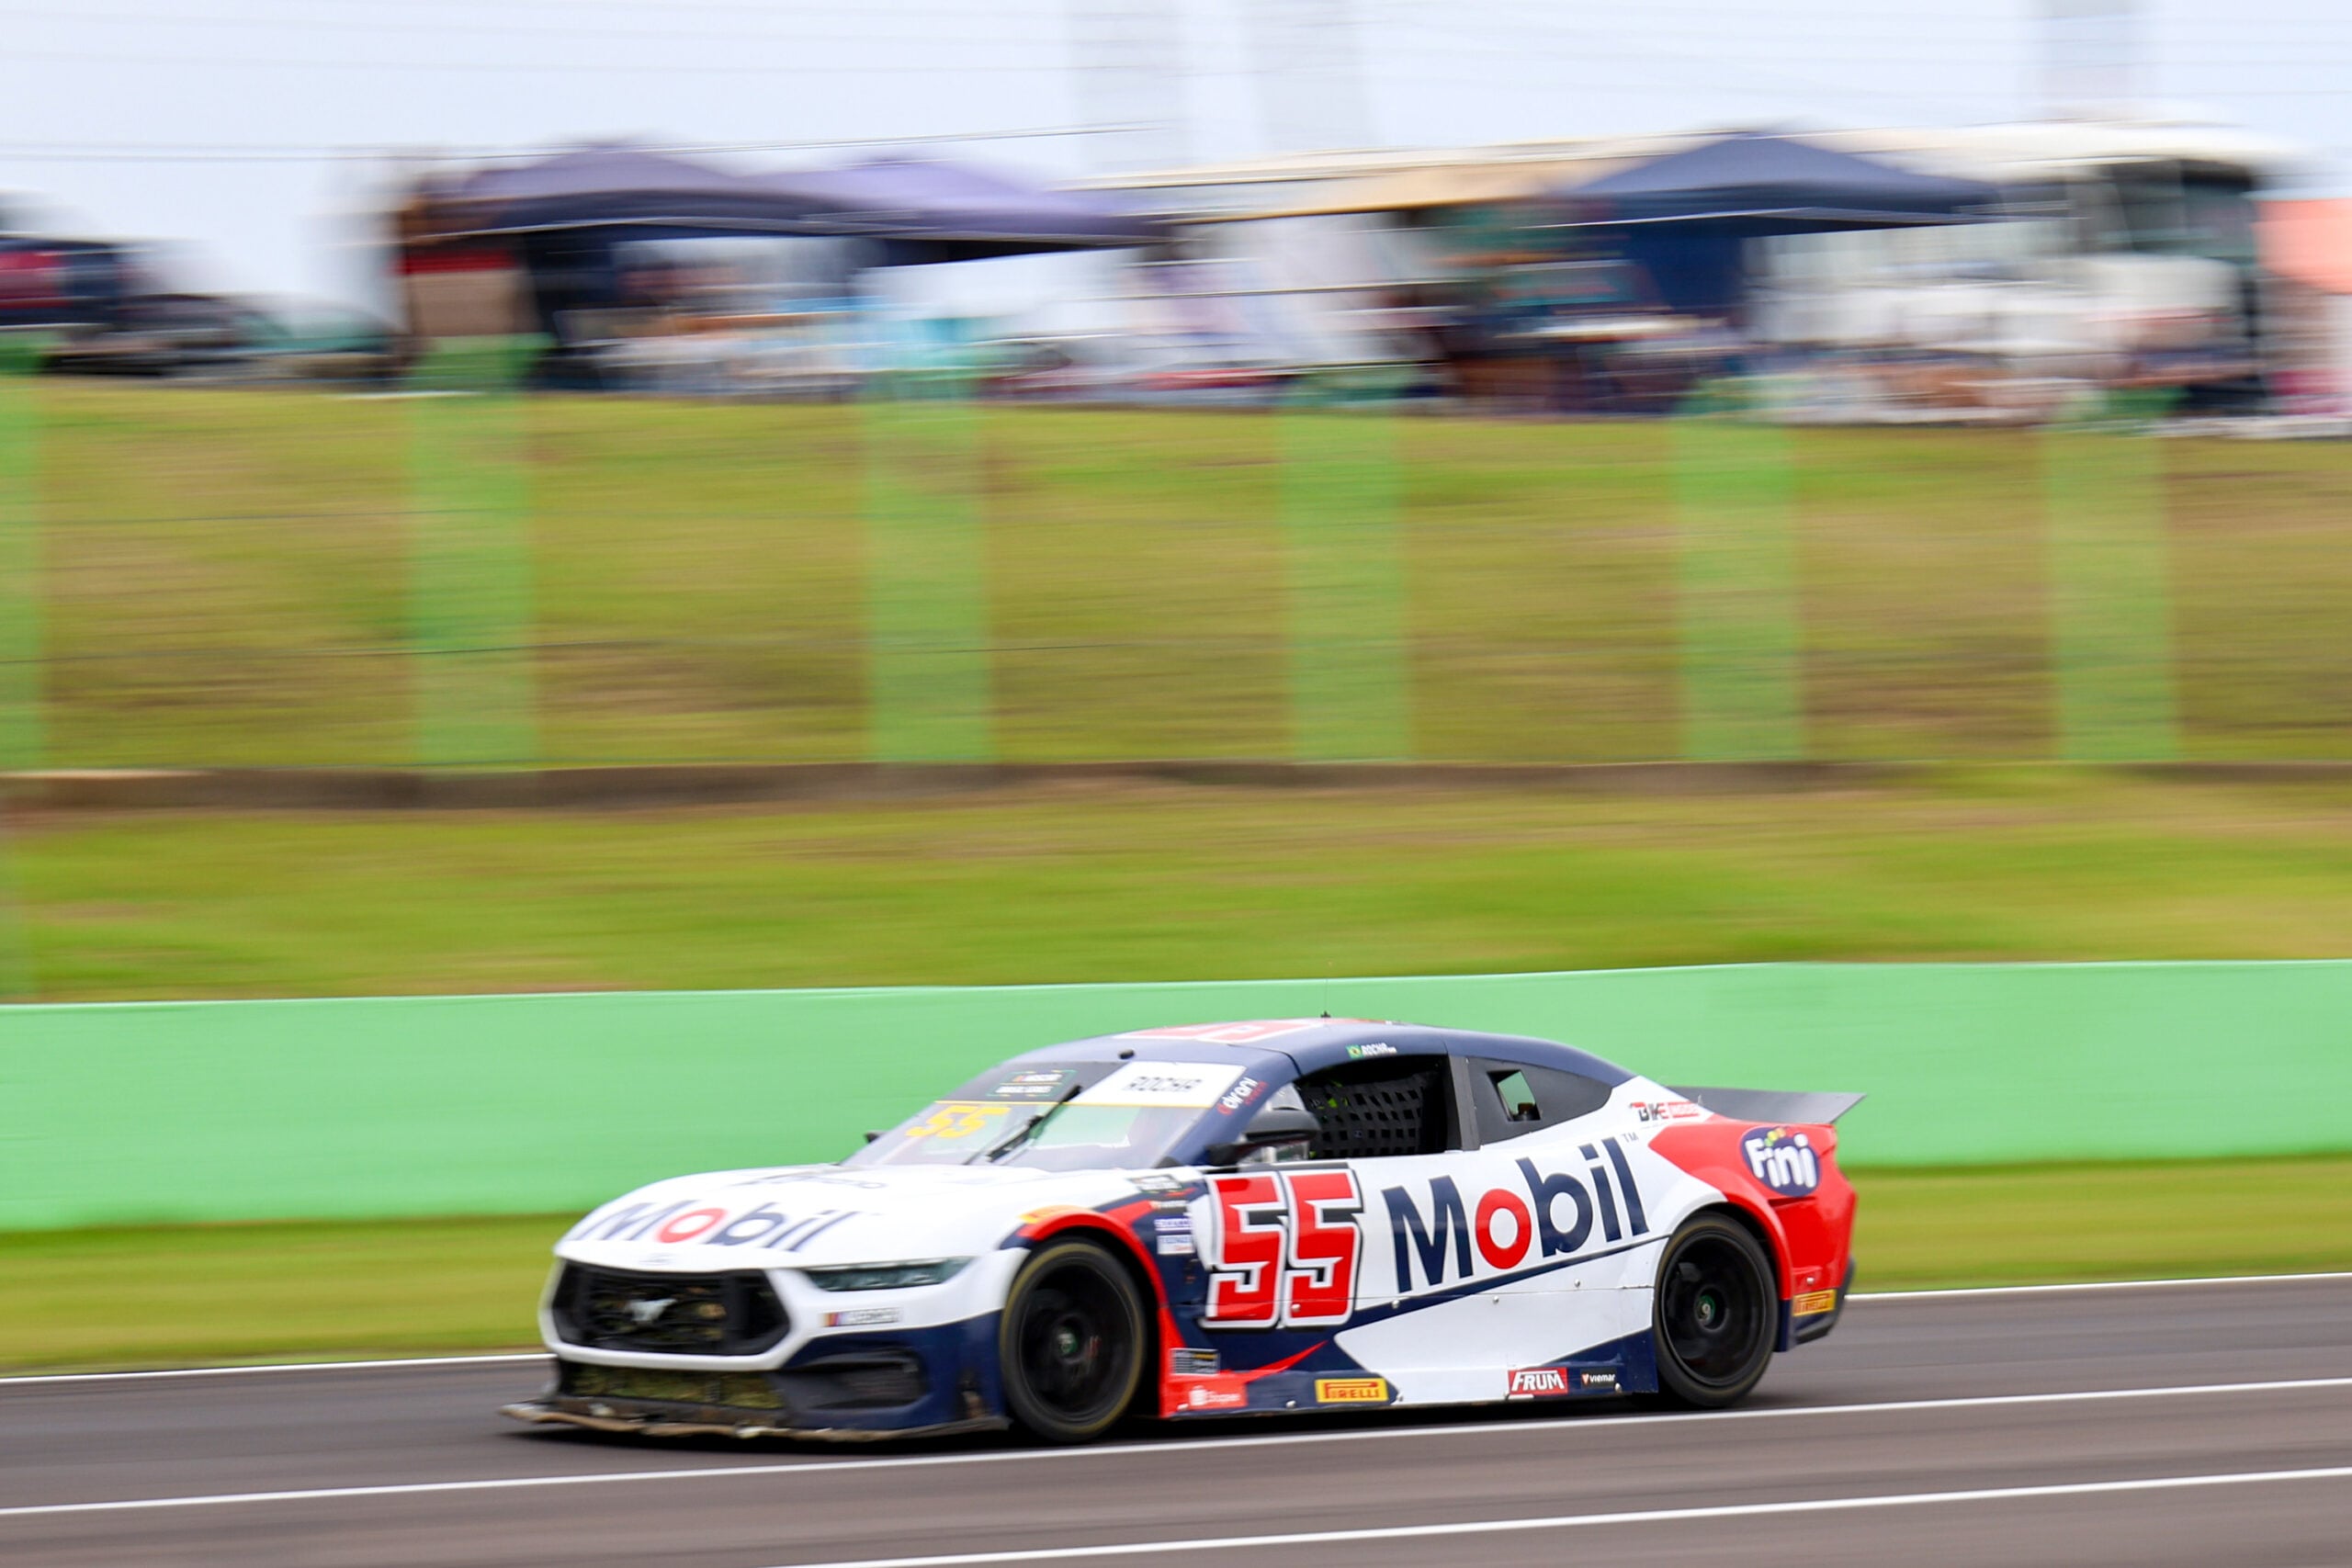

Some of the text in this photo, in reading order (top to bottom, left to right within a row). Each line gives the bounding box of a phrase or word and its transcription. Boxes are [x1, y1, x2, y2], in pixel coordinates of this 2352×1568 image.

[904, 1105, 1011, 1137] 55
[1745, 1132, 1817, 1188] Fini
[574, 1199, 862, 1252] Mobil
[1381, 1137, 1649, 1293] Mobil
[1199, 1168, 1363, 1328] 55
[1324, 1381, 1380, 1399] PIRELLI
[1510, 1370, 1565, 1391] FRUM
